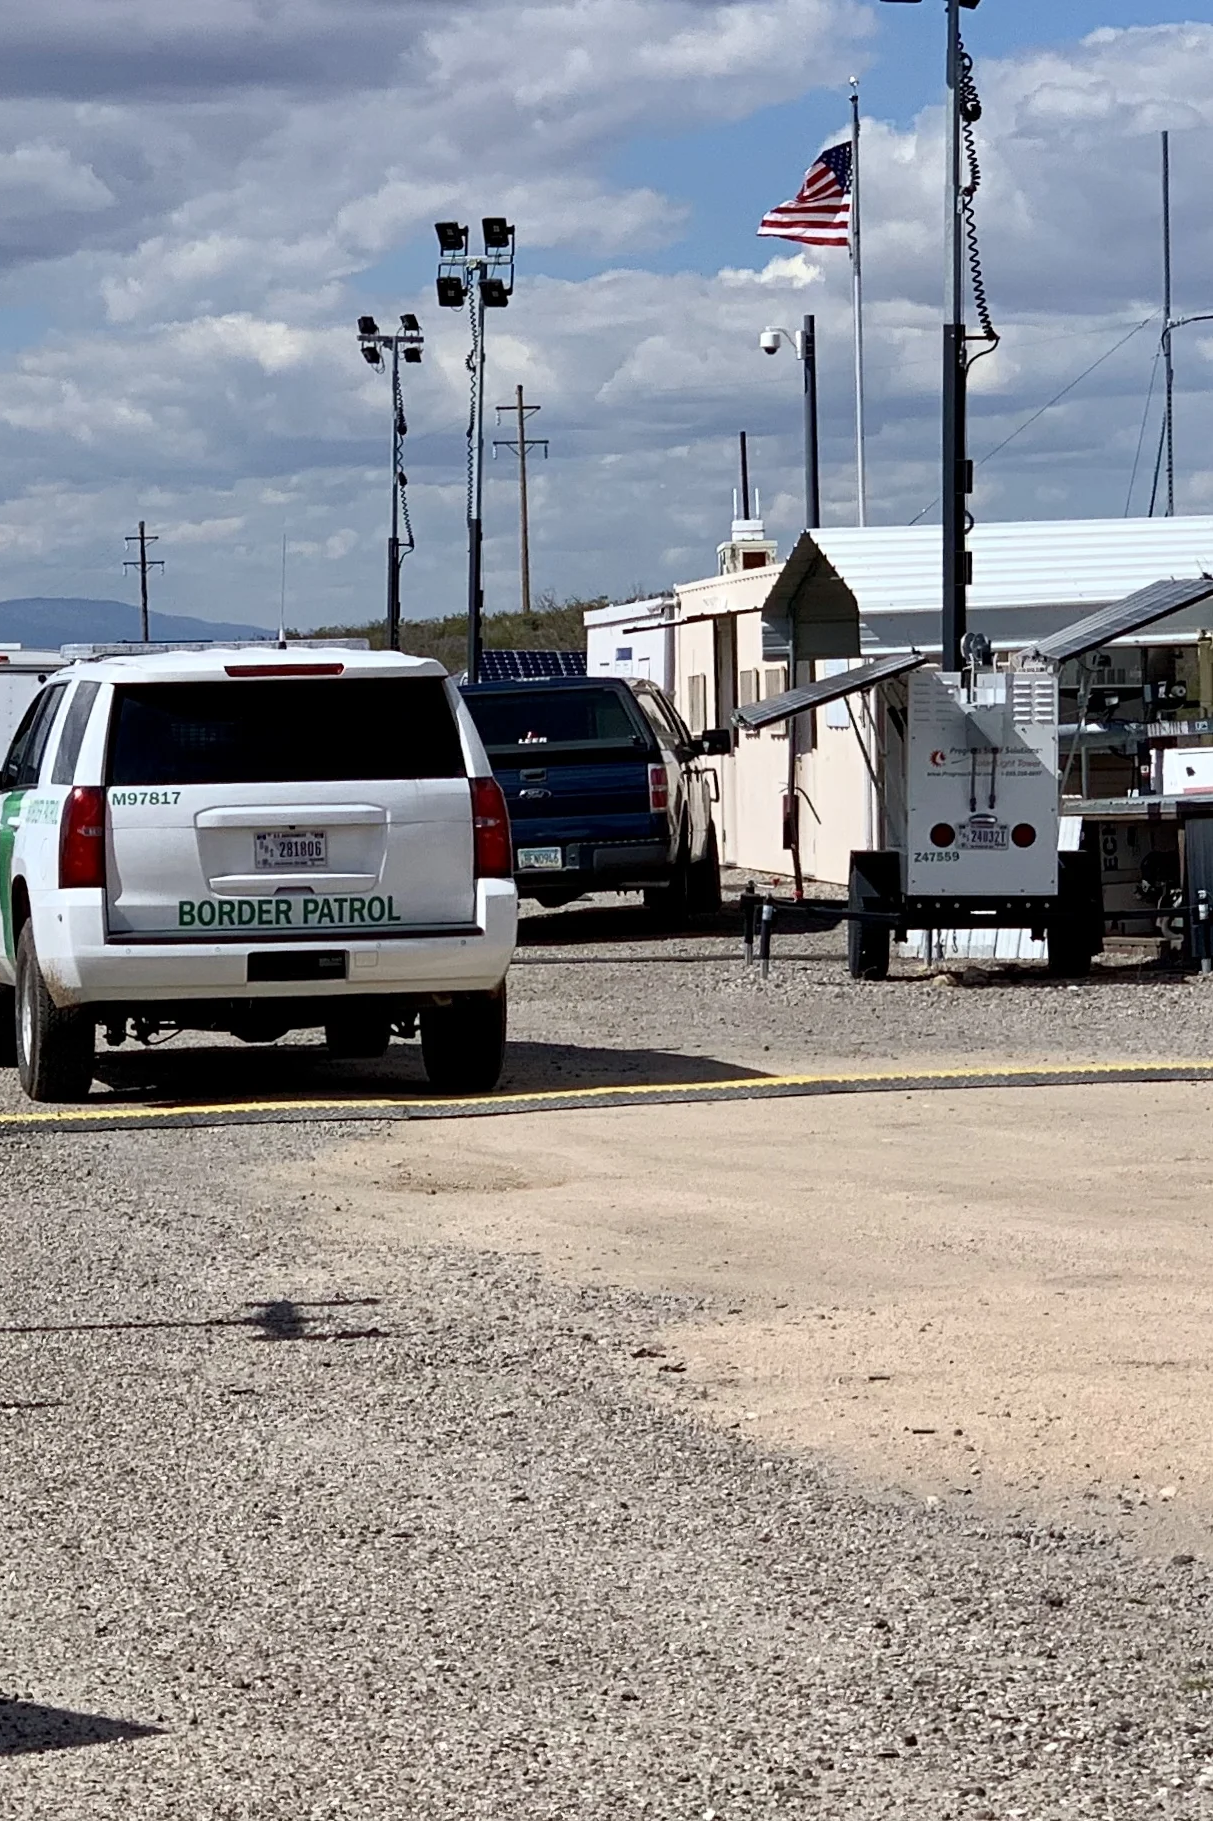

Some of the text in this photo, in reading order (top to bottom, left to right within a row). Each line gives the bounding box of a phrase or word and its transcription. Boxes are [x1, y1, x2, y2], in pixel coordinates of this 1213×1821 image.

[112, 792, 181, 805] M97817
[279, 841, 321, 857] 281806
[914, 852, 960, 863] Z47559
[178, 896, 401, 926] BORDER PATROL
